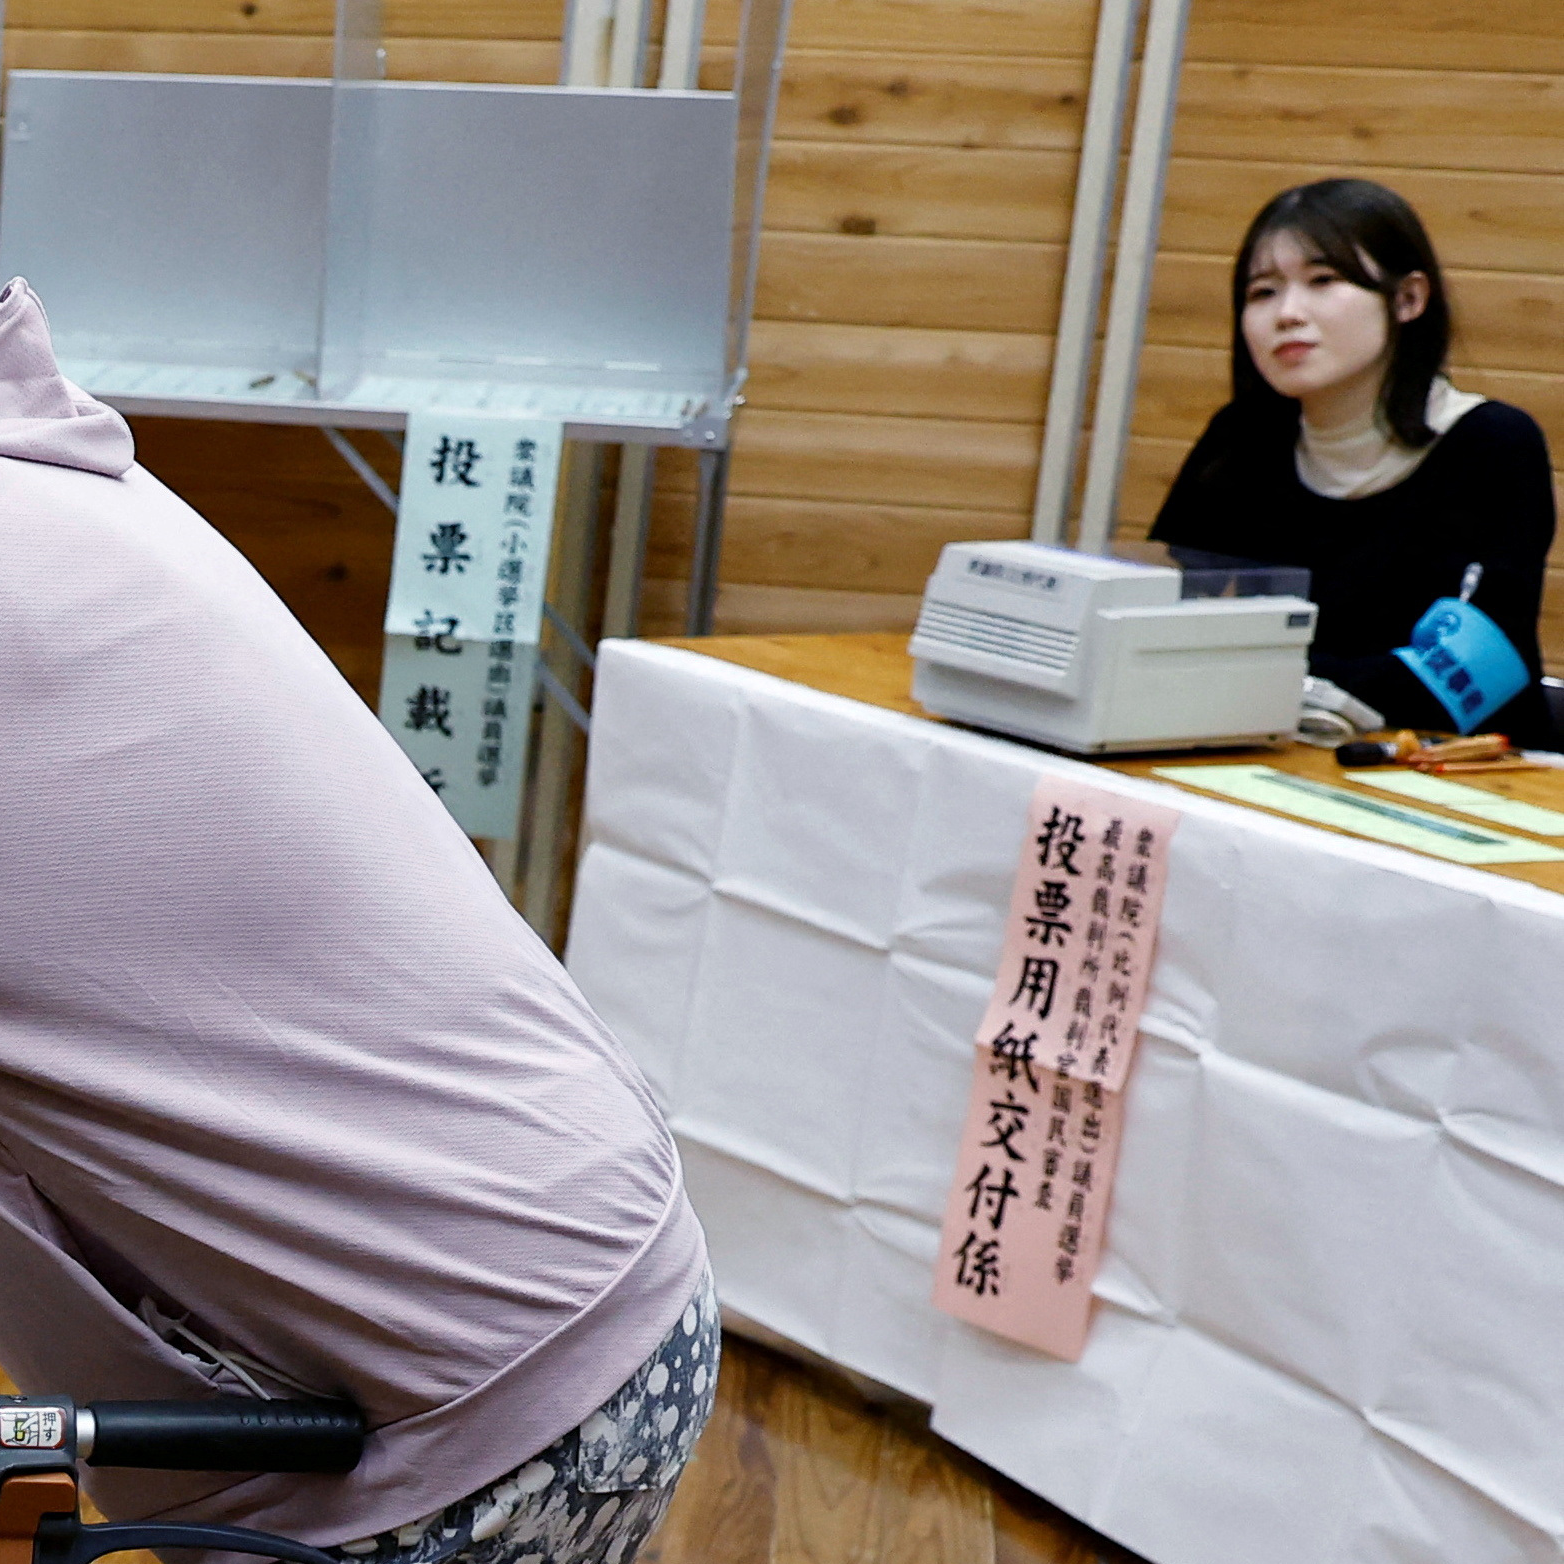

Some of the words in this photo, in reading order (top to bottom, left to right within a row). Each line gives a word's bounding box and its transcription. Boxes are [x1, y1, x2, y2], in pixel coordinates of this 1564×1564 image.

[953, 805, 1086, 1299] 投票用紙交付係
[42, 1412, 57, 1441] 押す
